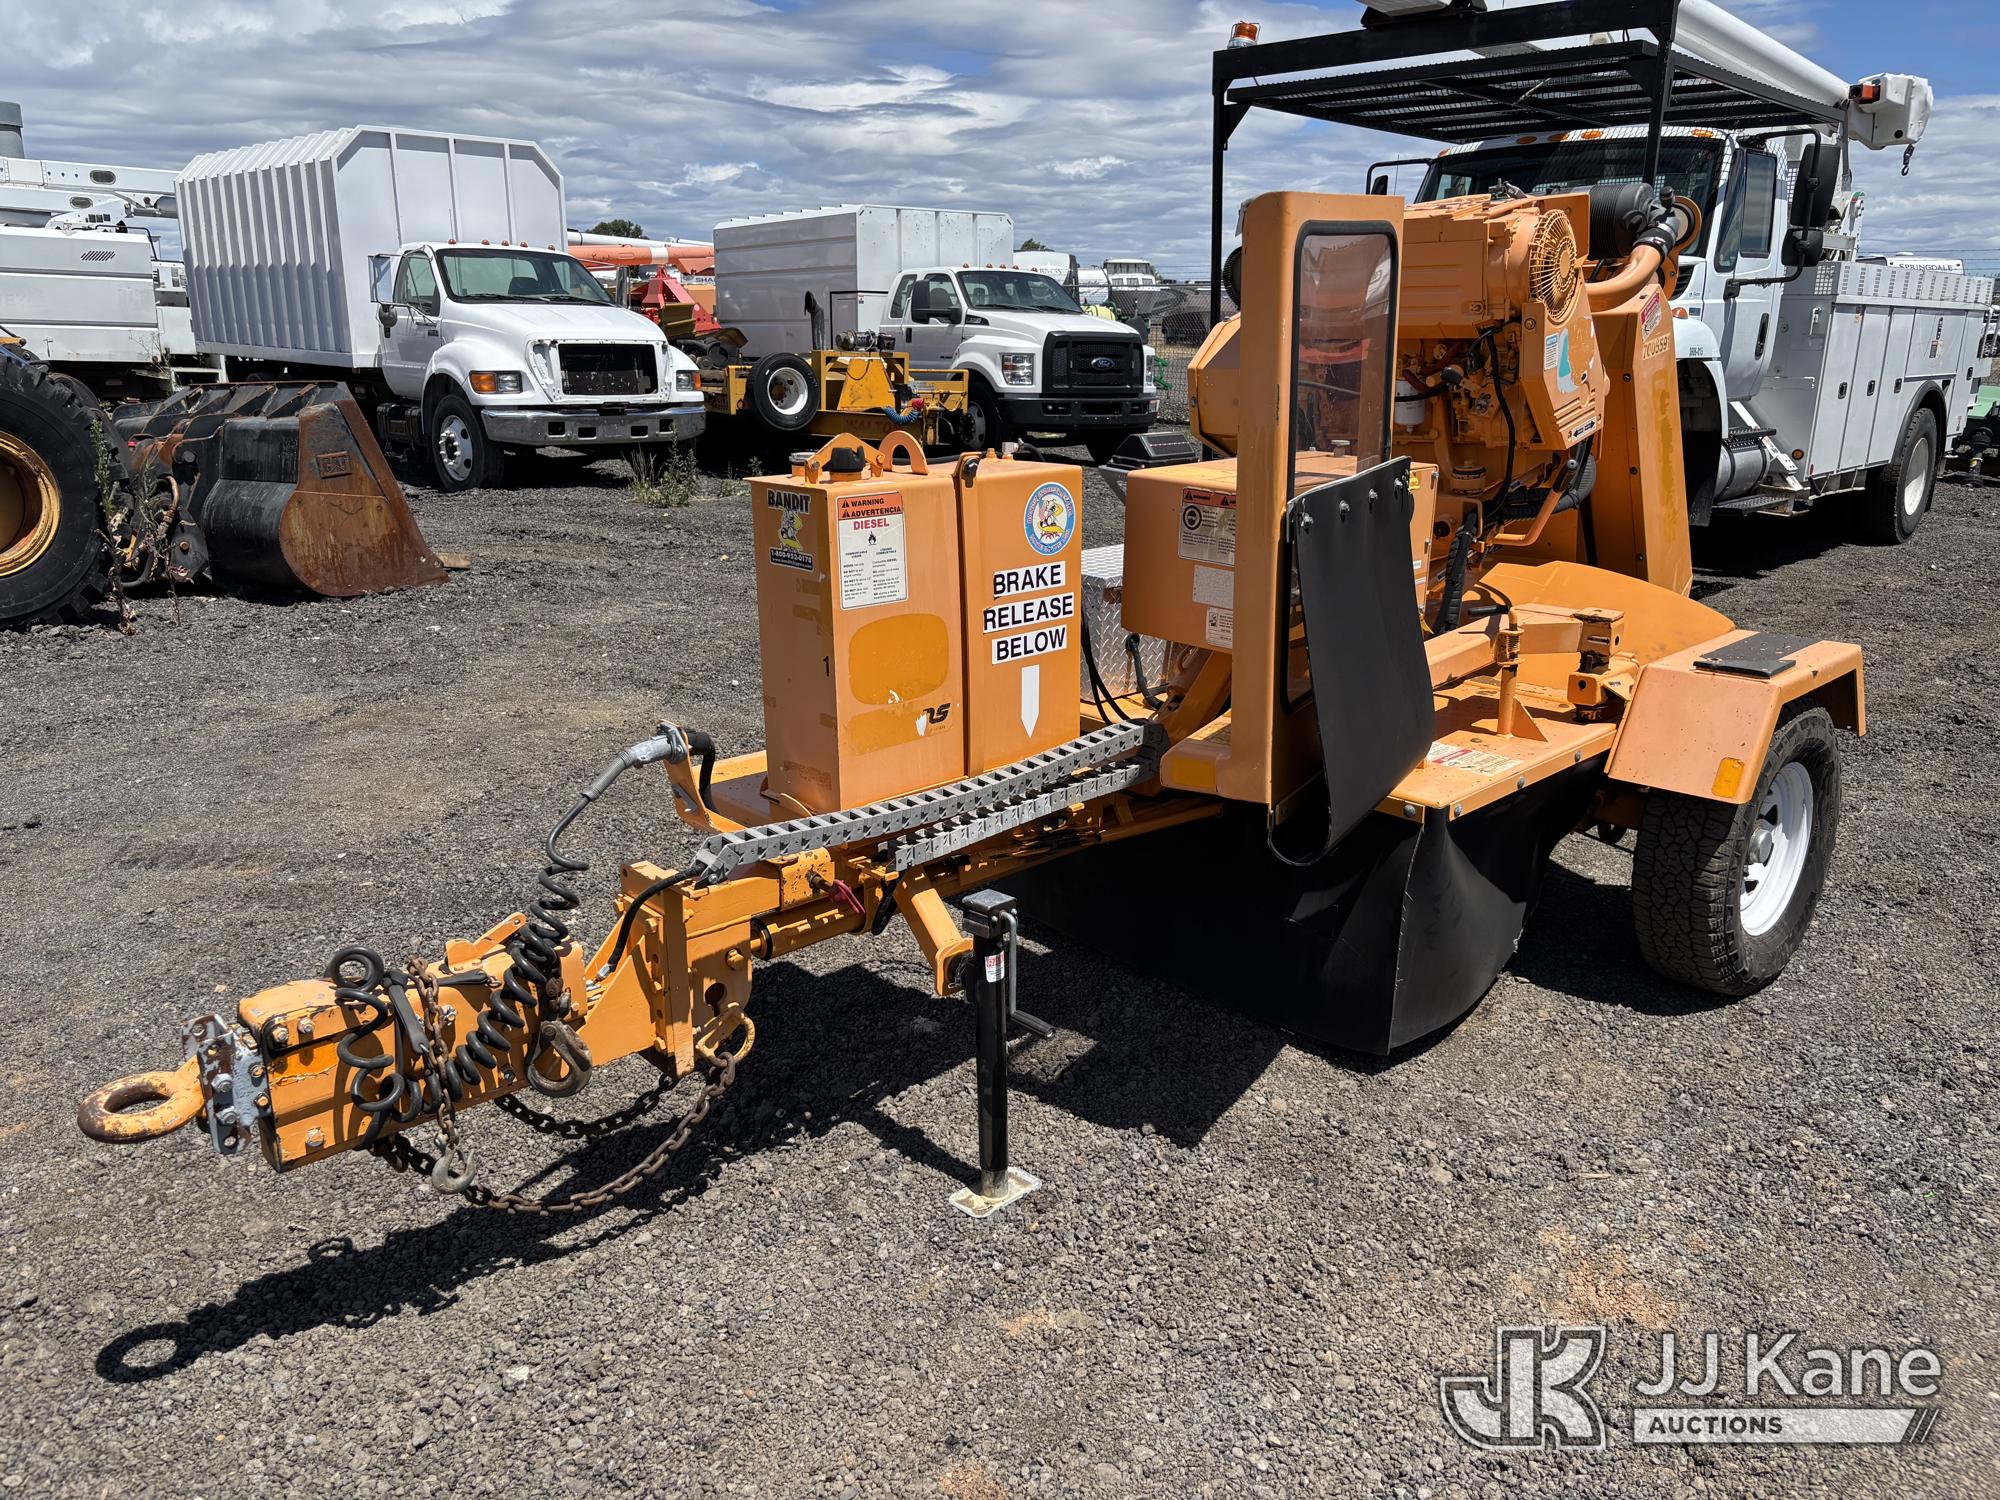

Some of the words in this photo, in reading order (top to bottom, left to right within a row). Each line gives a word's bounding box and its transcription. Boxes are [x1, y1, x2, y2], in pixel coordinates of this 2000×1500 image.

[1899, 263, 1953, 272] SPRINGDALE
[767, 489, 810, 513] BANDIT
[851, 498, 885, 507] WARNING
[851, 506, 902, 517] ADVERTENCIA
[854, 517, 890, 530] DIESEL
[993, 564, 1062, 595] BRAKE
[983, 595, 1073, 631] RELEASE
[996, 627, 1066, 661] BELOW
